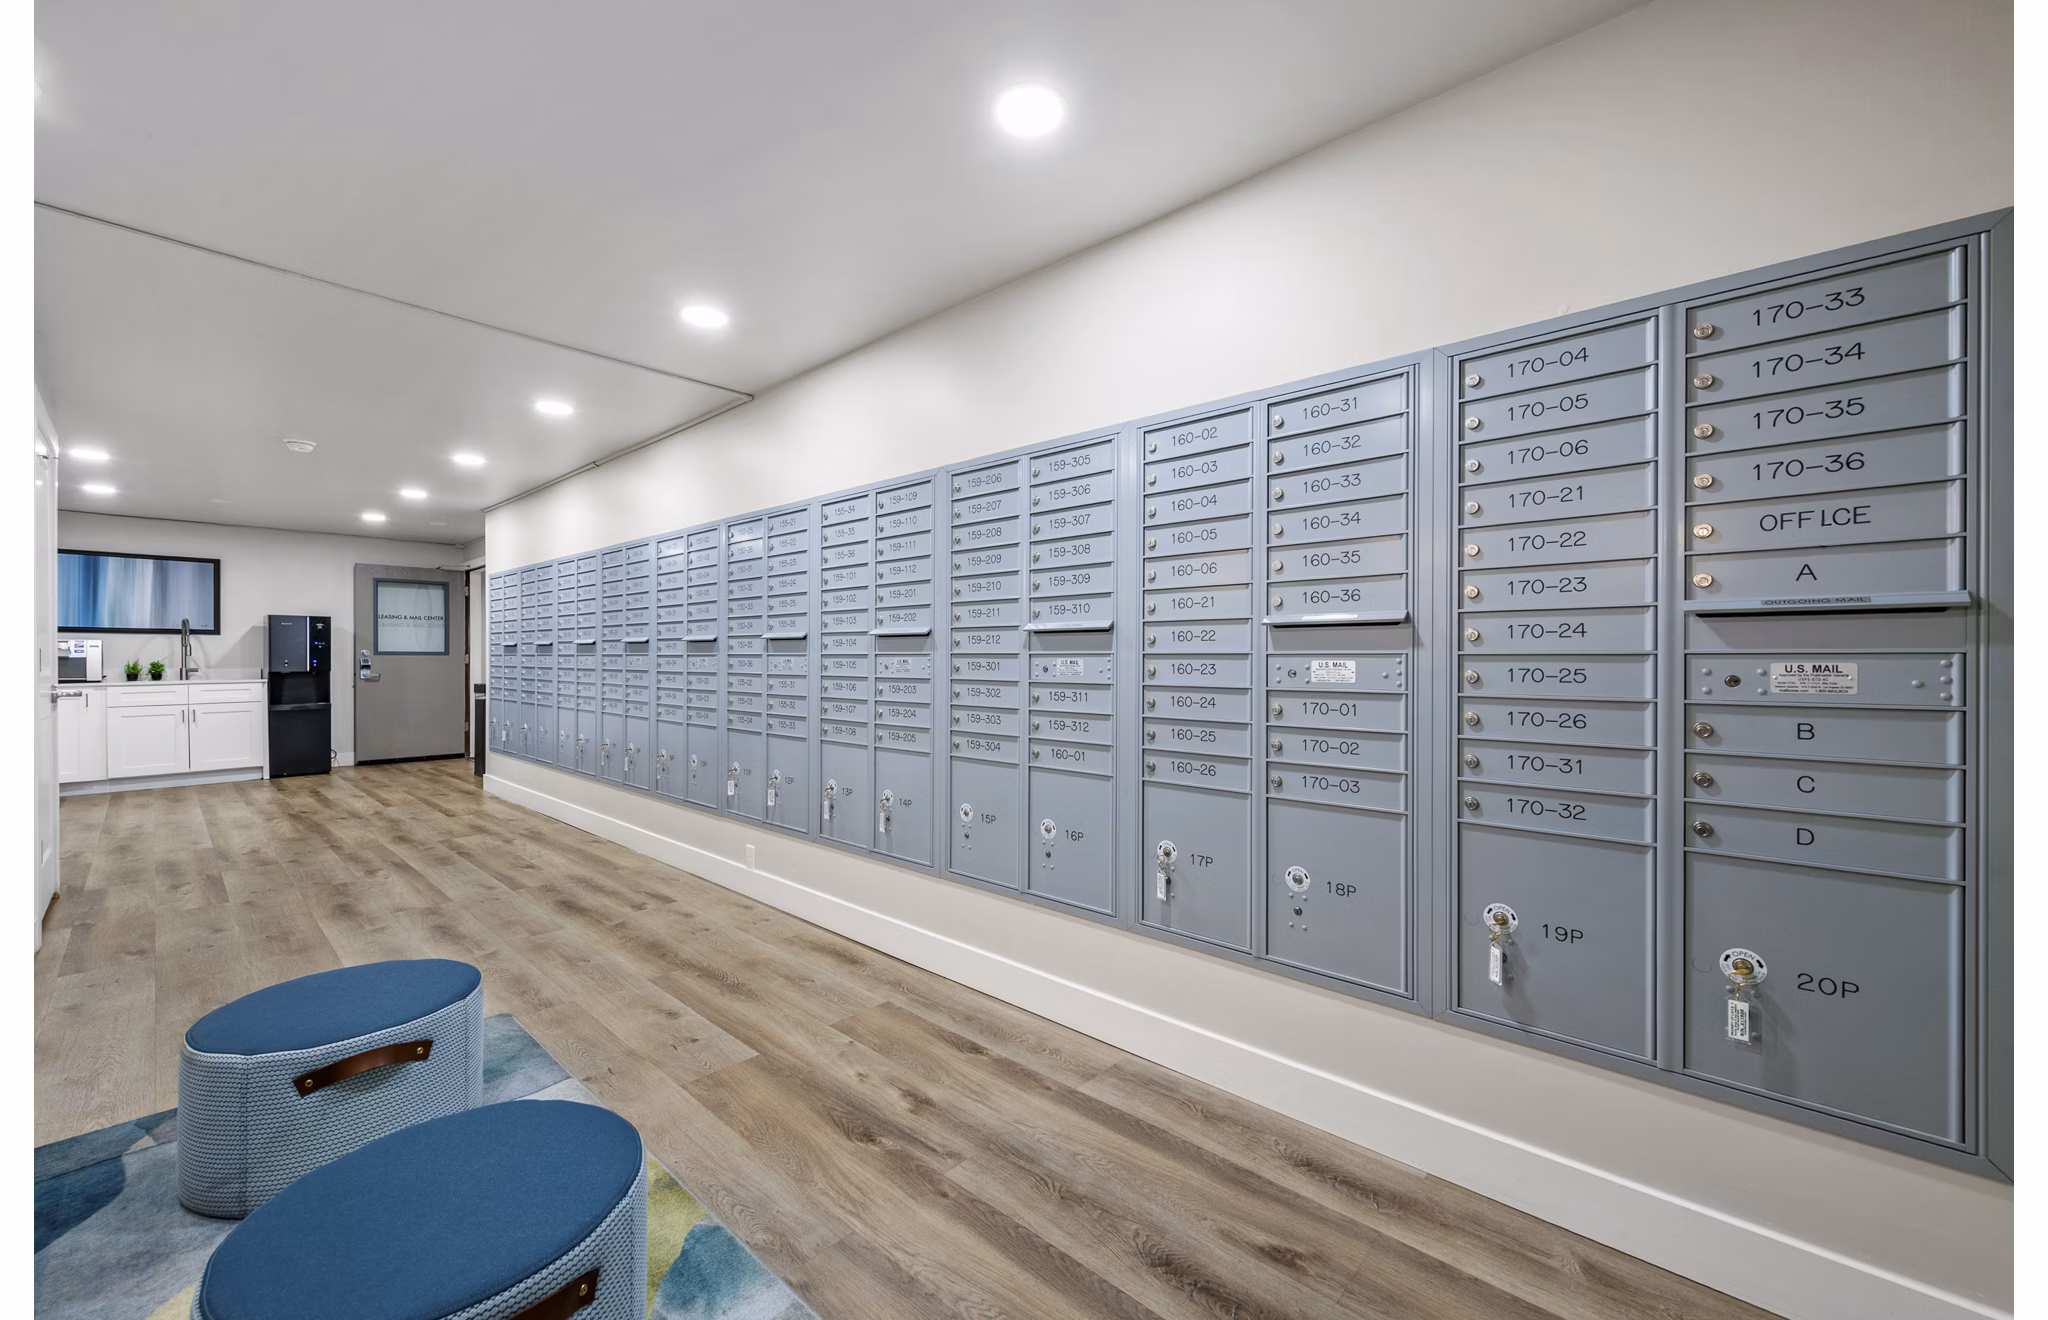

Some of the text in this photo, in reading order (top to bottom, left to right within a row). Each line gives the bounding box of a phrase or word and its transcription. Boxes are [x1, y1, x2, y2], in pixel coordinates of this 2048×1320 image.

[1752, 287, 1865, 326] 170-33
[1507, 347, 1589, 378] 170-04
[1752, 342, 1865, 378] 170-34
[1302, 397, 1357, 420] 160-31
[1507, 393, 1589, 421] 170-05
[1752, 397, 1865, 429] 170-35
[1172, 427, 1218, 446] 160-02
[1303, 434, 1361, 456] 160-32
[1508, 439, 1588, 464] 170-06
[1049, 454, 1091, 471] 159-305
[1172, 460, 1218, 479] 160-03
[1753, 452, 1865, 481] 170-36
[968, 473, 1002, 488] 159-206
[1303, 473, 1361, 493] 160-33
[889, 491, 918, 505] 159-109
[1049, 484, 1091, 500] 159-306
[1509, 485, 1582, 508] 170-21
[968, 499, 1002, 514] 159-207
[1172, 494, 1218, 511] 160-04
[835, 505, 855, 516] 155-34
[889, 515, 917, 528] 159-110
[1049, 513, 1091, 529] 159-307
[1303, 511, 1361, 530] 160-34
[835, 527, 855, 538] 155-35
[968, 526, 1002, 540] 159-208
[1172, 528, 1217, 544] 160-05
[889, 540, 916, 552] 159-111
[1508, 531, 1587, 551] 170-22
[835, 549, 855, 560] 155-36
[1049, 543, 1091, 558] 159-308
[968, 553, 1002, 566] 159-209
[1303, 550, 1361, 567] 160-35
[833, 571, 856, 582] 159-101
[889, 564, 916, 576] 159-112
[1172, 562, 1217, 577] 160-06
[1796, 564, 1817, 581] A
[968, 580, 1001, 593] 159-210
[1049, 573, 1091, 587] 159-309
[1508, 577, 1587, 595] 170-23
[833, 593, 856, 604] 159-102
[889, 588, 916, 599] 159-201
[1303, 588, 1361, 604] 160-36
[1049, 602, 1090, 615] 159-310
[1172, 596, 1214, 609] 160-21
[833, 616, 857, 625] 159-103
[889, 612, 917, 623] 159-202
[968, 608, 1000, 619] 159-211
[1172, 629, 1216, 642] 160-22
[1508, 623, 1587, 639] 170-24
[832, 638, 857, 647] 159-104
[968, 634, 1001, 645] 159-212
[833, 660, 856, 669] 159-105
[967, 661, 1000, 671] 159-301
[1171, 663, 1217, 675] 160-23
[1784, 664, 1843, 673] U.S. MAIL
[1508, 668, 1587, 684] 170-25
[833, 682, 856, 692] 159-106
[888, 684, 917, 694] 159-203
[967, 687, 1001, 698] 159-302
[1049, 691, 1088, 702] 159-311
[1171, 696, 1216, 708] 160-24
[832, 704, 856, 713] 159-107
[888, 708, 916, 718] 159-204
[1303, 702, 1356, 716] 170-01
[967, 713, 1001, 725] 159-303
[1049, 720, 1089, 732] 159-312
[1508, 711, 1587, 729] 170-26
[832, 726, 856, 736] 159-108
[888, 732, 916, 743] 159-205
[1171, 728, 1216, 743] 160-25
[1797, 723, 1815, 740] B
[966, 740, 1001, 751] 159-304
[1302, 739, 1360, 755] 170-02
[1051, 748, 1085, 761] 160-01
[1171, 761, 1217, 777] 160-26
[1508, 755, 1582, 774] 170-31
[1302, 775, 1360, 794] 170-03
[1797, 775, 1815, 793] C
[842, 788, 853, 796] 13P
[899, 798, 912, 807] 14P
[1507, 798, 1586, 821] 170-32
[981, 813, 996, 824] 15P
[1065, 829, 1084, 842] 16P
[1797, 828, 1814, 846] D
[1191, 854, 1213, 867] 17P
[1327, 881, 1357, 897] 18P
[1494, 905, 1510, 914] OPEN
[1542, 924, 1583, 944] 19P
[1732, 950, 1756, 960] OPEN
[1797, 973, 1859, 998] 20P
